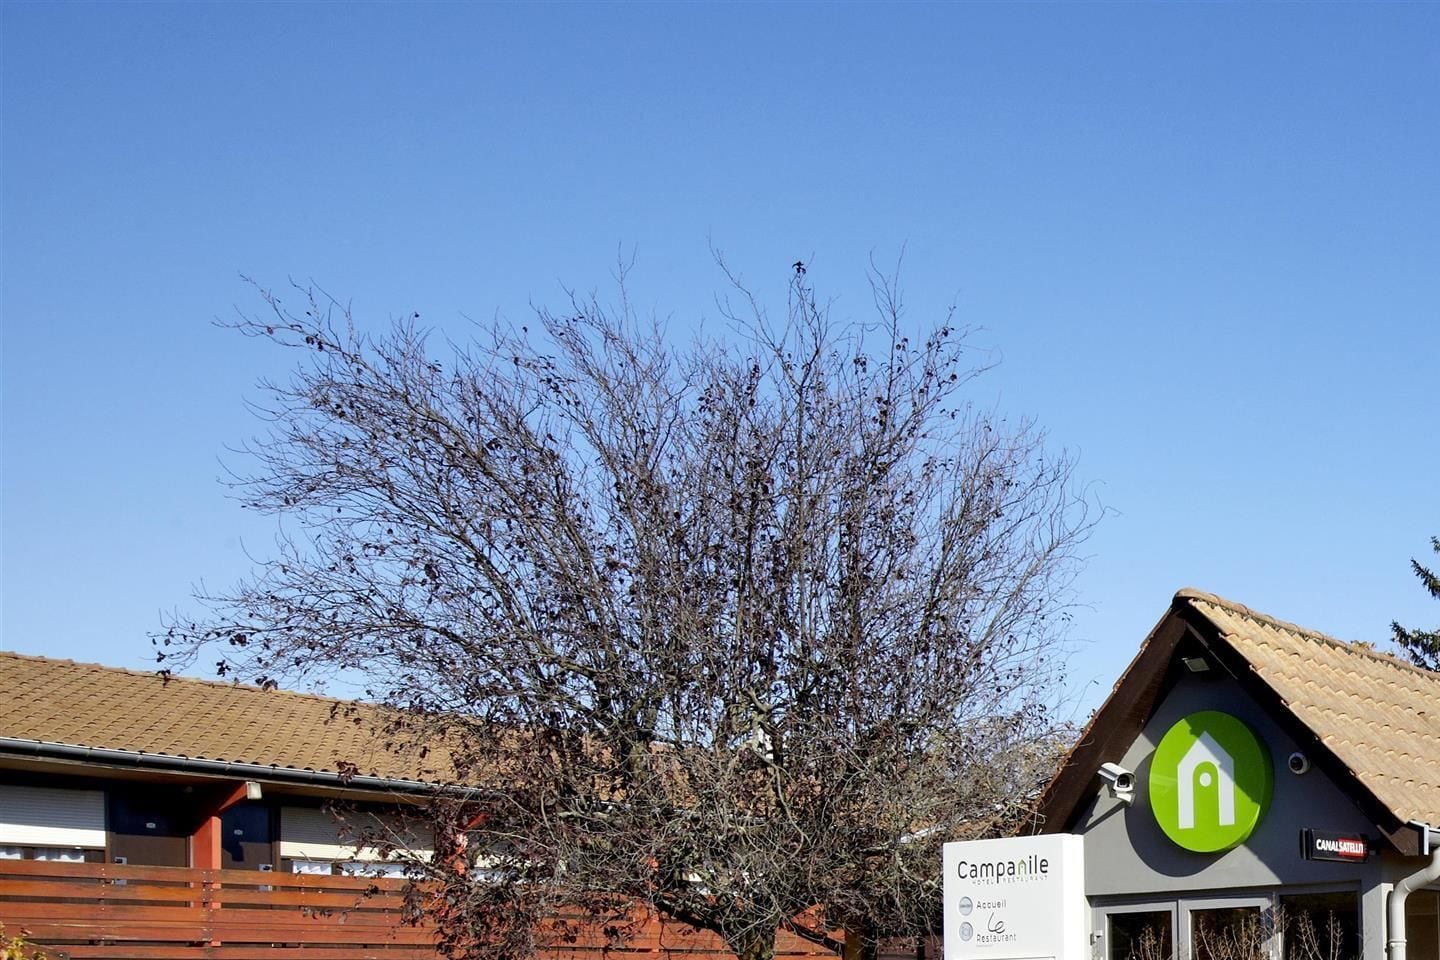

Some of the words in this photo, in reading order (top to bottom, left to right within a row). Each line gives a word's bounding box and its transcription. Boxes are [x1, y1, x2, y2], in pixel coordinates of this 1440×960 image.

[957, 854, 1049, 884] Campanile
[976, 899, 1007, 909] Accueil
[976, 933, 1017, 943] Restaurant
